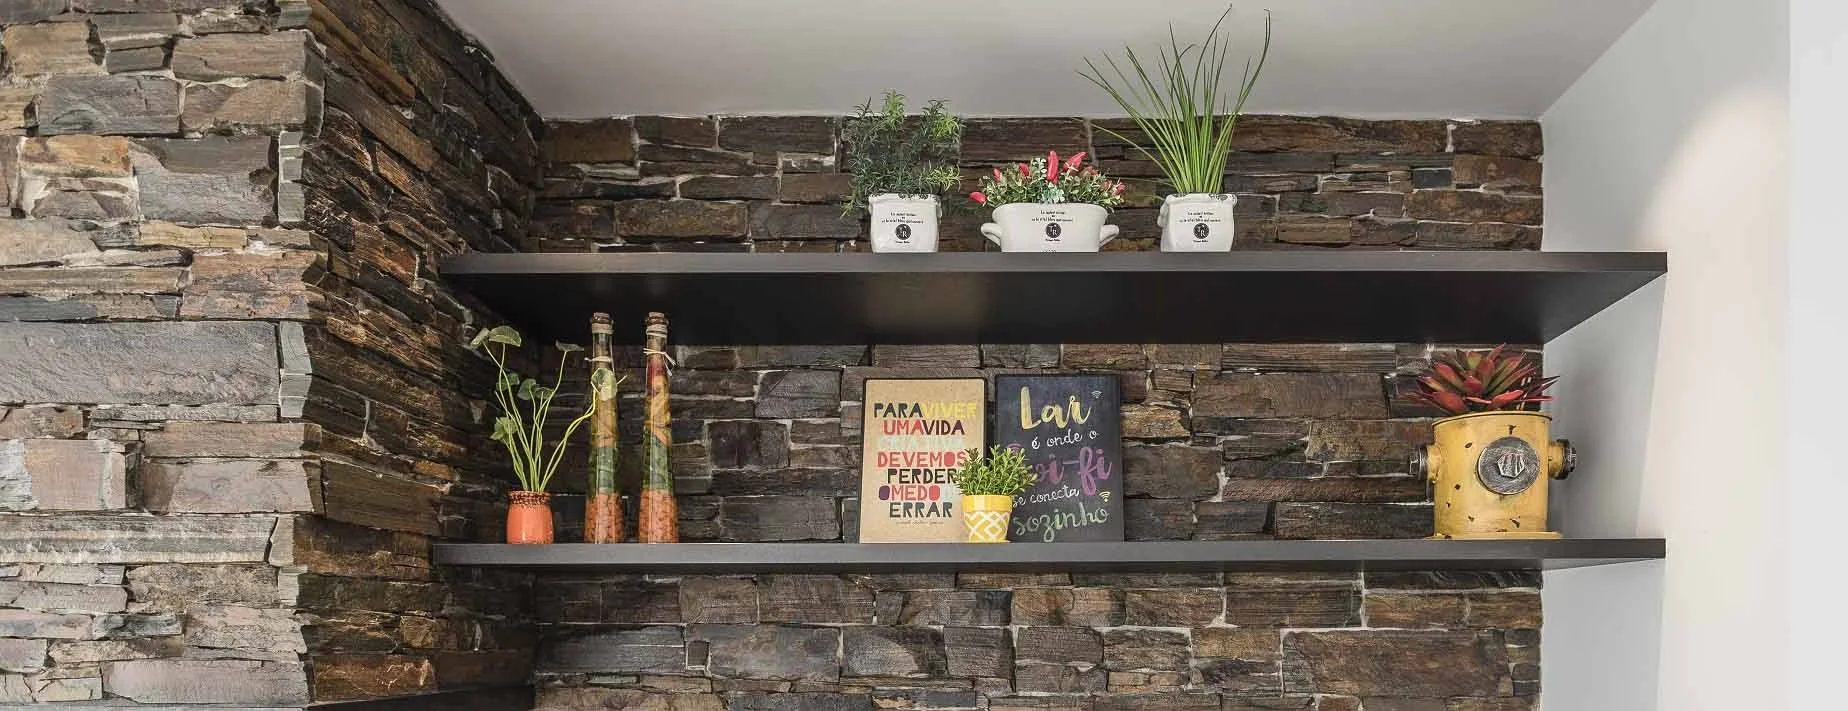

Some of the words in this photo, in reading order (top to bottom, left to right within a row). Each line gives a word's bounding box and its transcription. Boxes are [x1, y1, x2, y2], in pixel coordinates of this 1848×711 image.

[874, 402, 923, 418] PARA
[1020, 386, 1092, 430] Lar
[883, 419, 924, 435] UMA
[922, 419, 965, 435] VIDA
[1032, 436, 1041, 449] é
[1046, 428, 1083, 447] onde
[1089, 430, 1099, 440] o
[877, 451, 968, 467] DEVEMOS
[887, 468, 958, 484] PERDER
[891, 485, 941, 501] MEDO
[1030, 484, 1080, 504] conecta
[889, 501, 953, 518] ERRAR
[1012, 502, 1111, 543] sozinho
